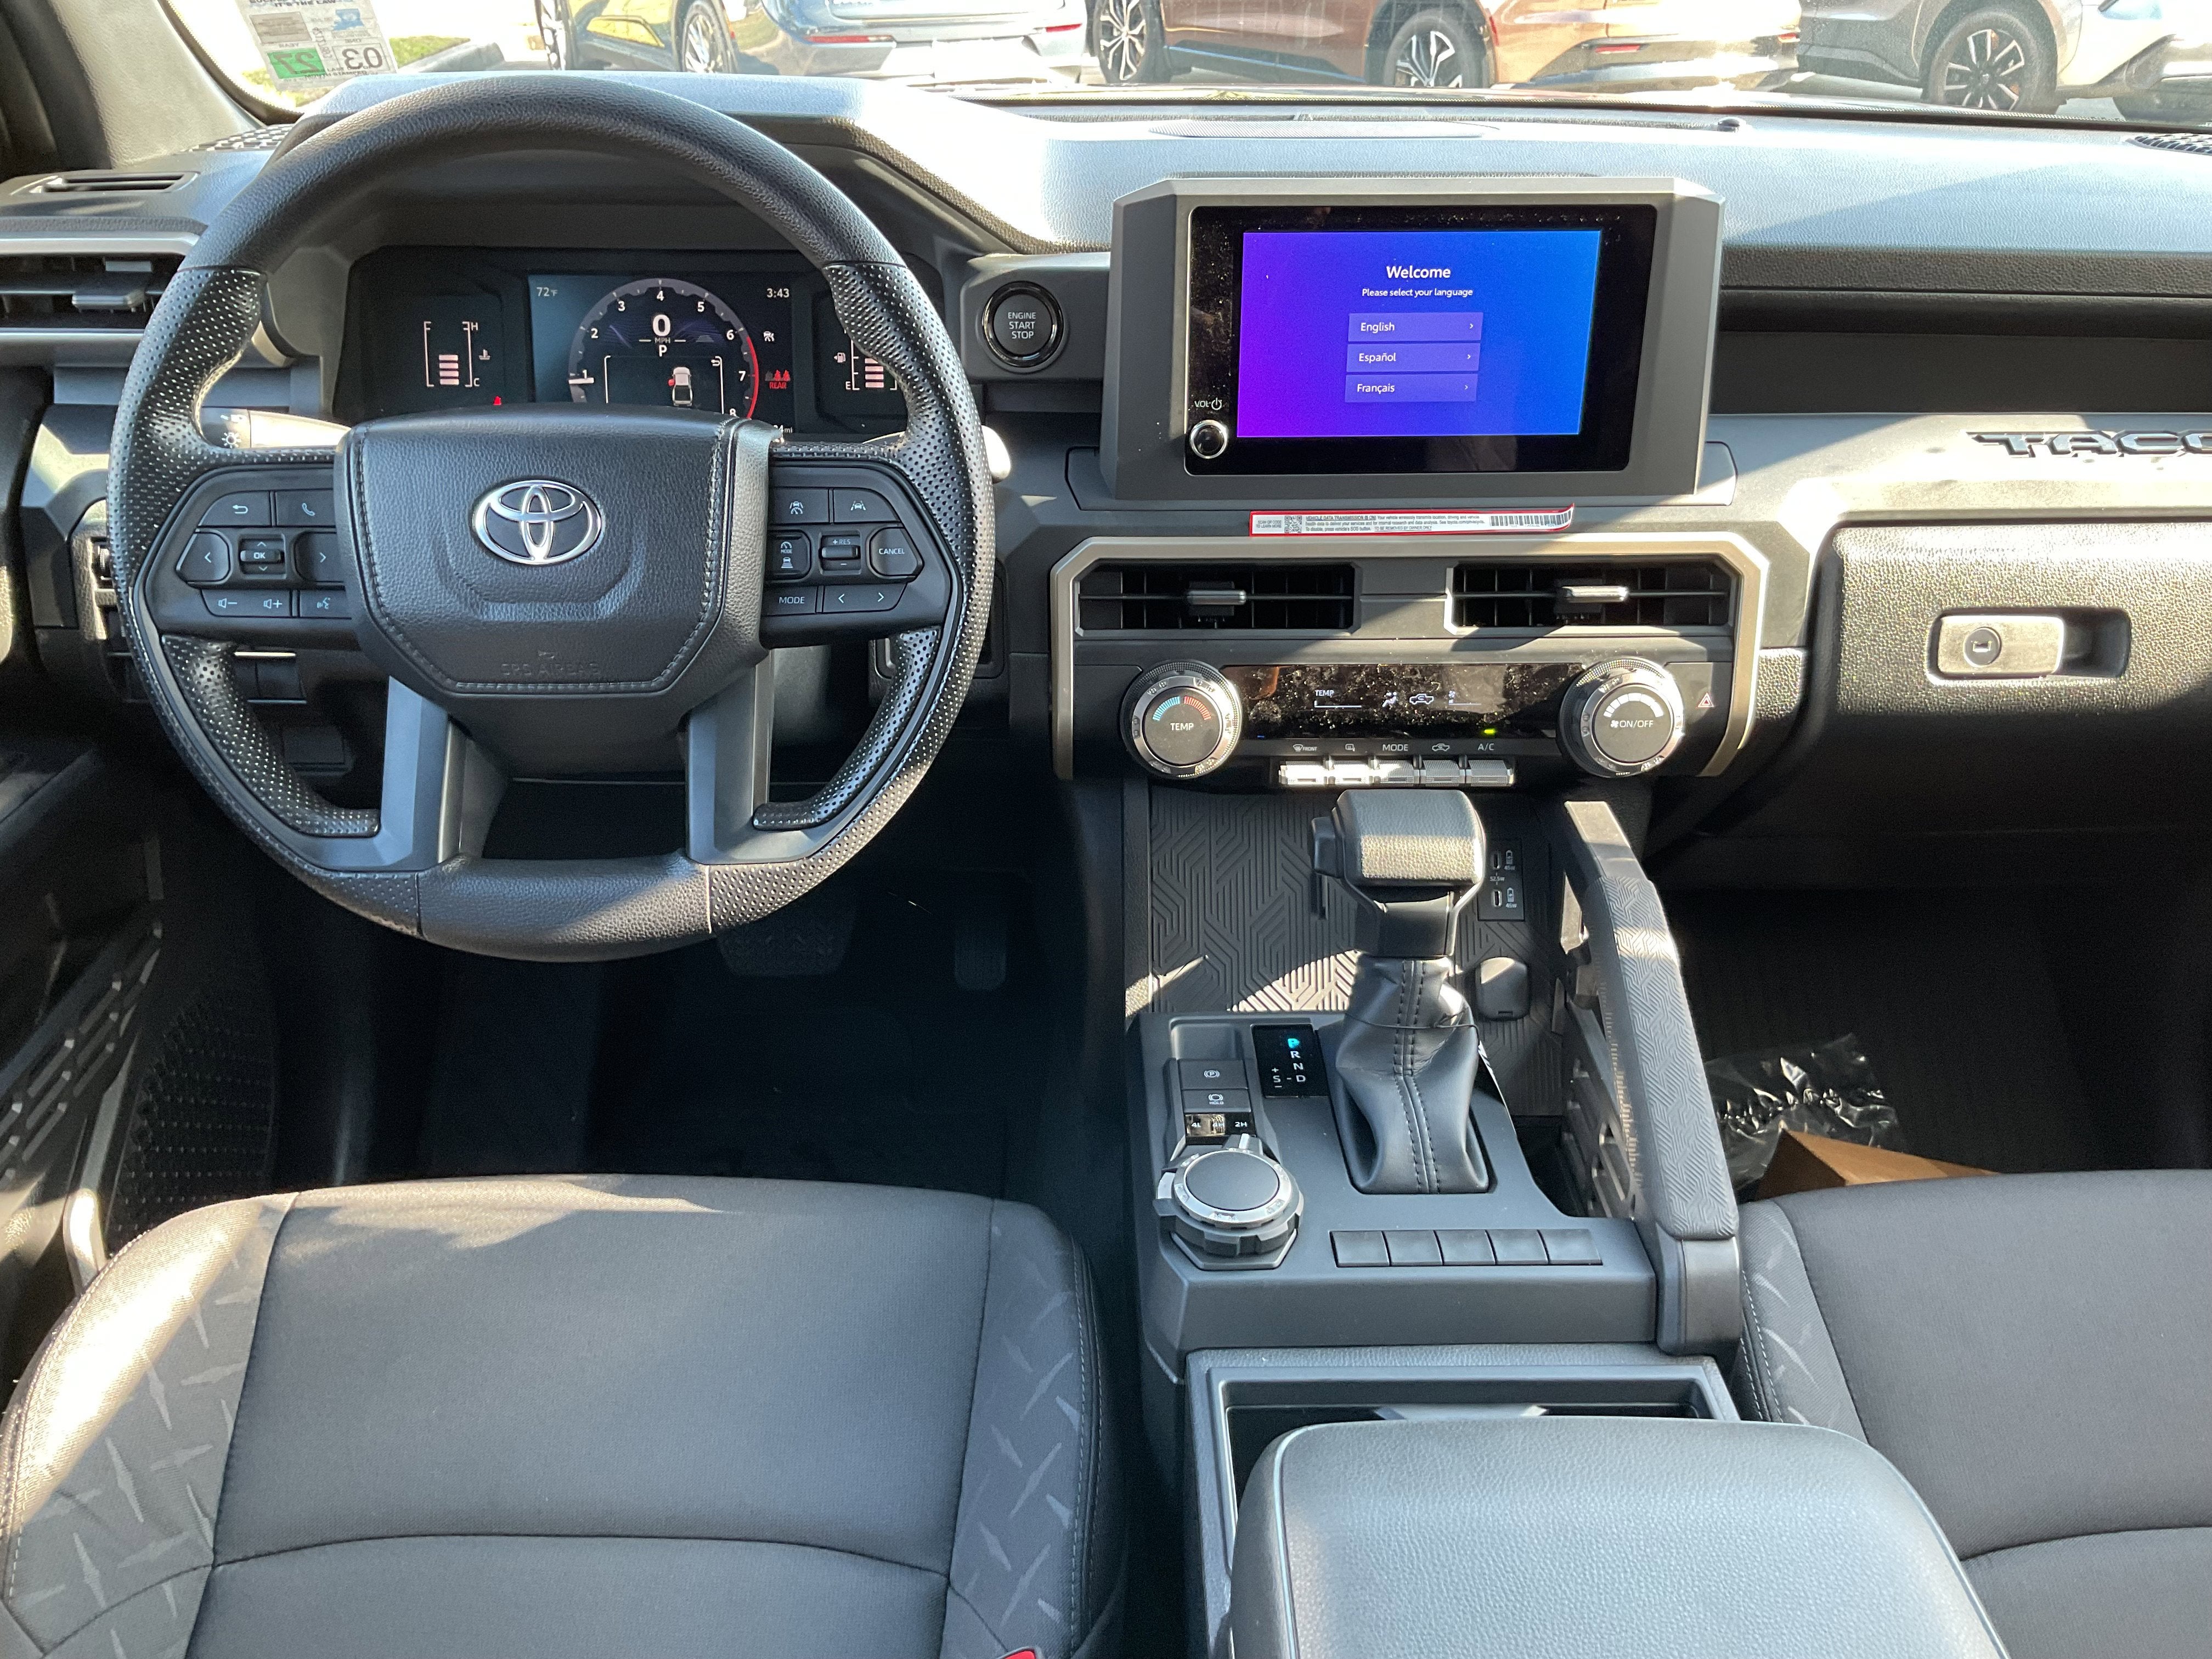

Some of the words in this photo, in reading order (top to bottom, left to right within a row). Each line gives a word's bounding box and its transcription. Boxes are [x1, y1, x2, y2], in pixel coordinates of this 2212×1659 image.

[1386, 266, 1451, 278] Welcome
[657, 290, 664, 301] 4
[766, 288, 790, 298] 3:43
[1414, 290, 1432, 298] your
[1434, 288, 1473, 298] language
[618, 301, 625, 312] 3
[697, 301, 705, 312] 5
[471, 322, 478, 330] H
[652, 314, 671, 337] 0
[1009, 321, 1035, 329] START
[1361, 322, 1395, 334] English
[591, 329, 599, 338] 2
[726, 330, 734, 340] 6
[1012, 331, 1034, 339] STOP
[659, 345, 667, 357] P
[1359, 353, 1396, 364] Español
[583, 369, 588, 379] 1
[738, 371, 746, 381] 7
[845, 381, 851, 390] E
[1357, 383, 1395, 394] Français
[1170, 723, 1194, 731] TEMP
[1620, 720, 1654, 728] ON/OFF
[1477, 743, 1494, 751] A/C
[1288, 1038, 1300, 1048] P
